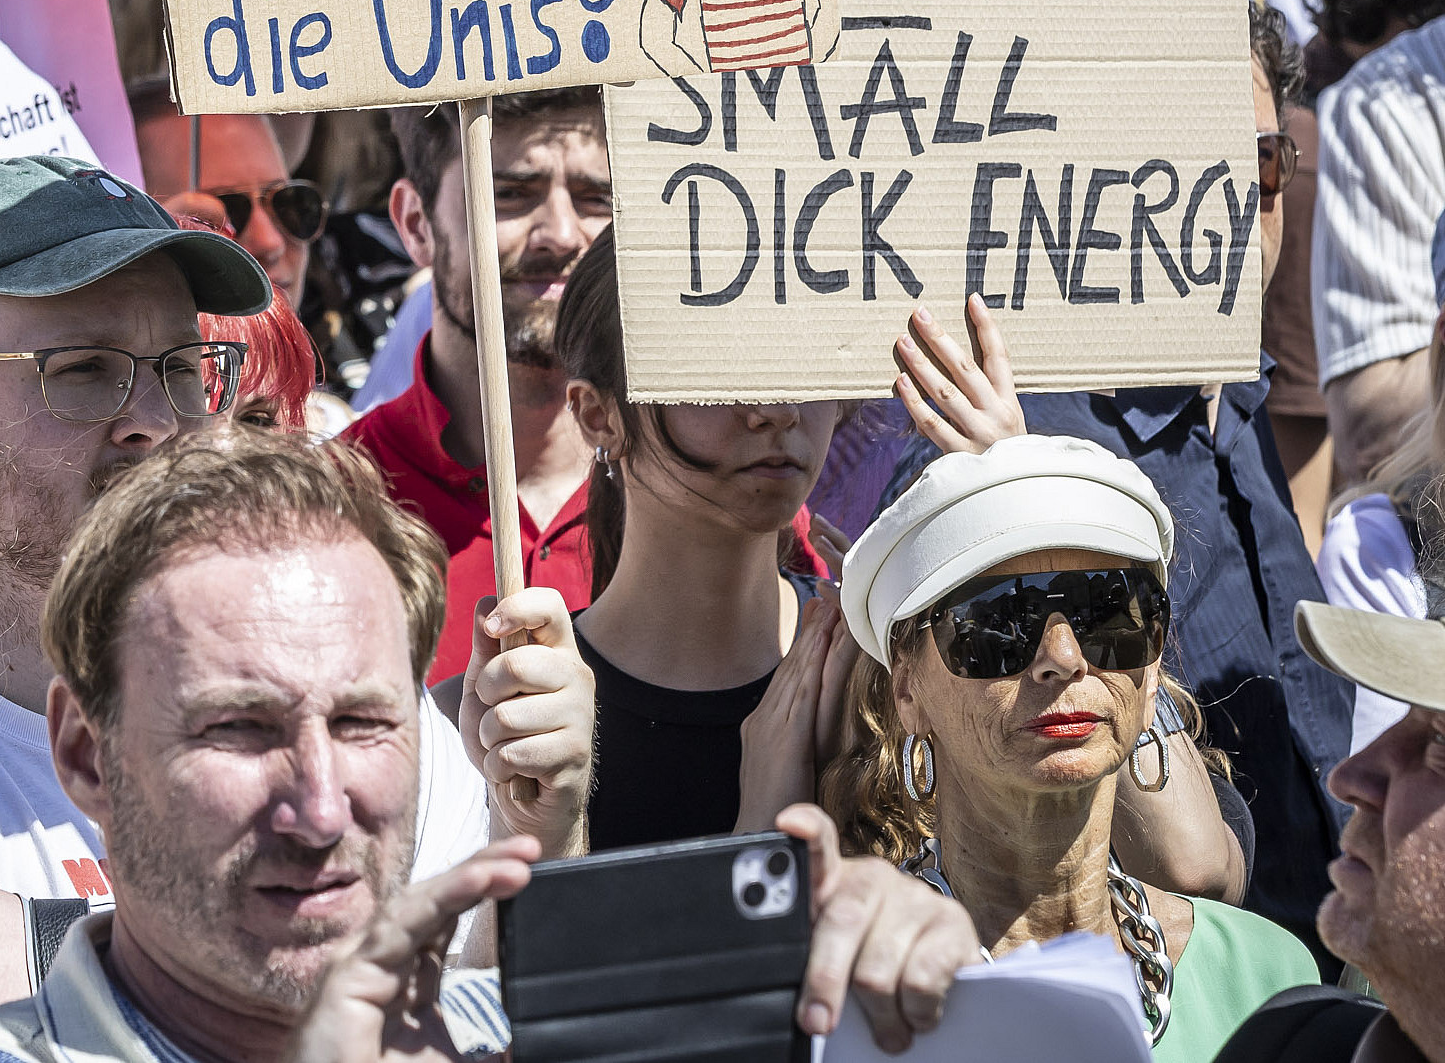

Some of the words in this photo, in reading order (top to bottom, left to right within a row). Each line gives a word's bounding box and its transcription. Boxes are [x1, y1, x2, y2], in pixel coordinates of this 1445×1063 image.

[647, 29, 1058, 160] SMALL
[661, 162, 924, 307] DICK
[965, 158, 1260, 316] ENERGY
[61, 857, 116, 899] M
